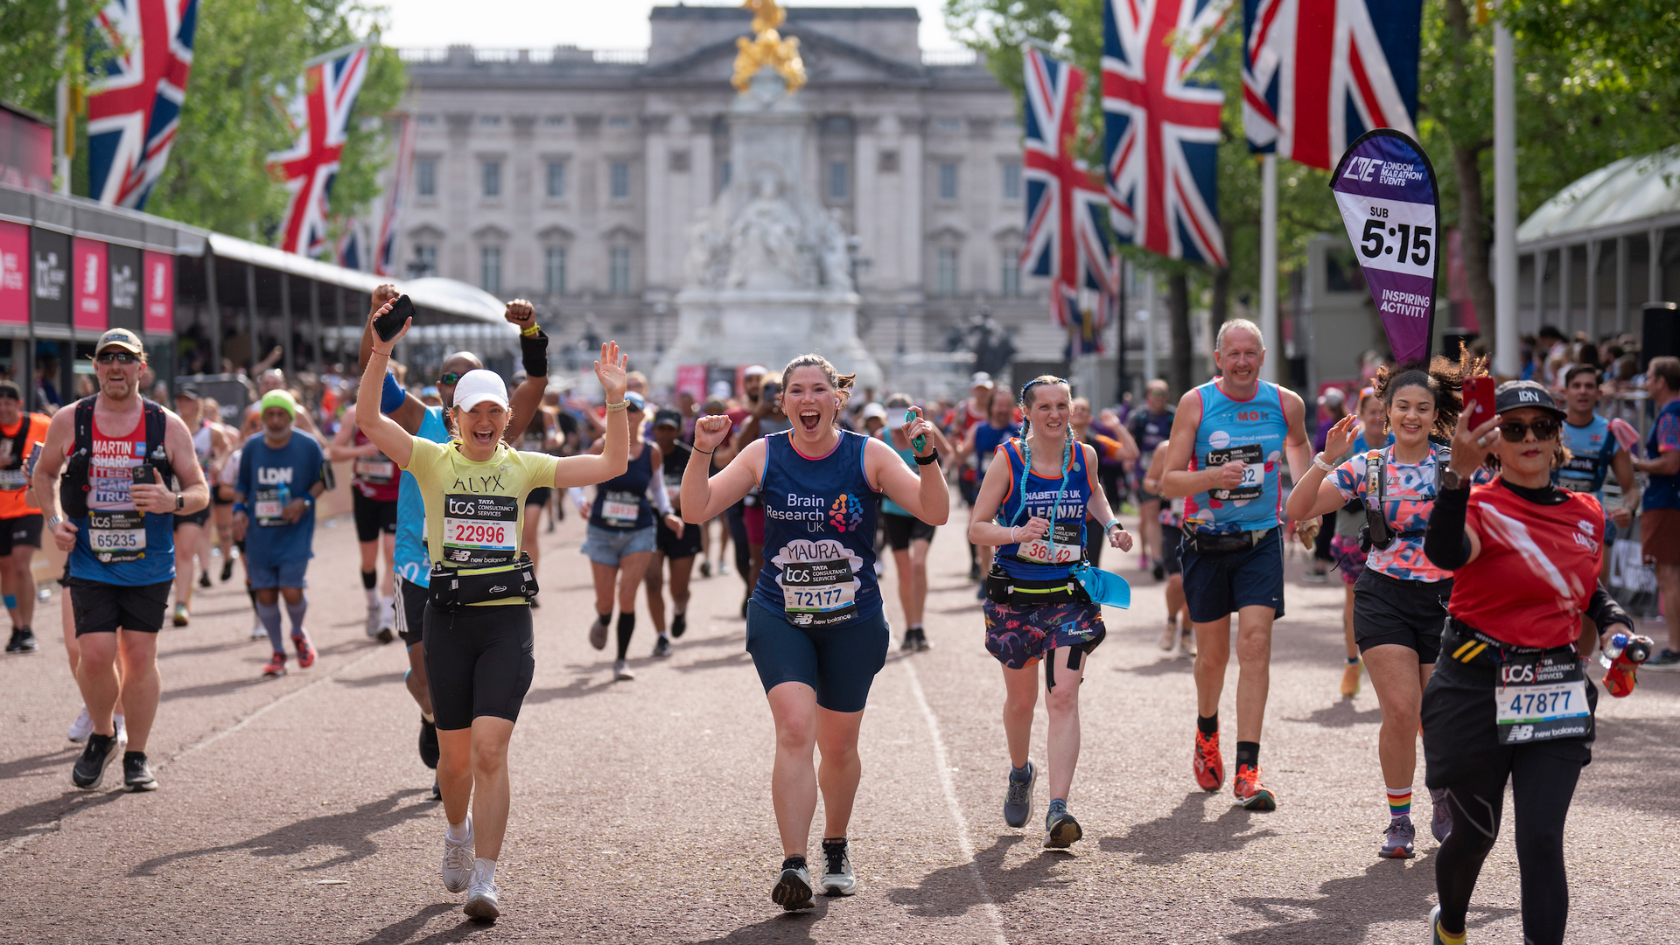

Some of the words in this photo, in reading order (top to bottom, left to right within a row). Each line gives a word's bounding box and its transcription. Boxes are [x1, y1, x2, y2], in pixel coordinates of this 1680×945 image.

[1382, 161, 1414, 172] LONDON
[1379, 175, 1407, 187] EVENTS
[1380, 168, 1423, 181] MARATHON
[1370, 206, 1389, 218] SUB
[1361, 219, 1432, 266] 5:15
[1381, 288, 1430, 307] INSPIRING
[1380, 300, 1426, 318] ACTIVITY
[1518, 390, 1540, 403] LDN
[92, 440, 132, 455] MARTIN
[93, 453, 130, 469] SHARP
[257, 466, 294, 485] LDN
[453, 474, 505, 493] ALYX
[787, 493, 825, 507] Brain
[1024, 490, 1069, 501] DIABETS
[1070, 490, 1081, 499] UK
[449, 498, 475, 515] tcs
[766, 504, 825, 521] Research
[91, 516, 111, 528] tcs
[807, 522, 825, 533] UK
[97, 534, 136, 547] 65235
[455, 524, 505, 543] 22996
[449, 549, 472, 562] NB
[786, 543, 841, 561] MAURA
[786, 566, 810, 582] tcs
[812, 568, 847, 577] CONSULTANCY
[812, 574, 837, 582] SERVICES
[794, 589, 842, 607] 72177
[793, 613, 814, 625] NB
[826, 614, 852, 624] balance
[1537, 672, 1564, 681] SERVICES
[1510, 691, 1572, 715] 47877
[1507, 725, 1534, 741] NB
[1534, 731, 1551, 739] new
[1552, 725, 1585, 736] balance
